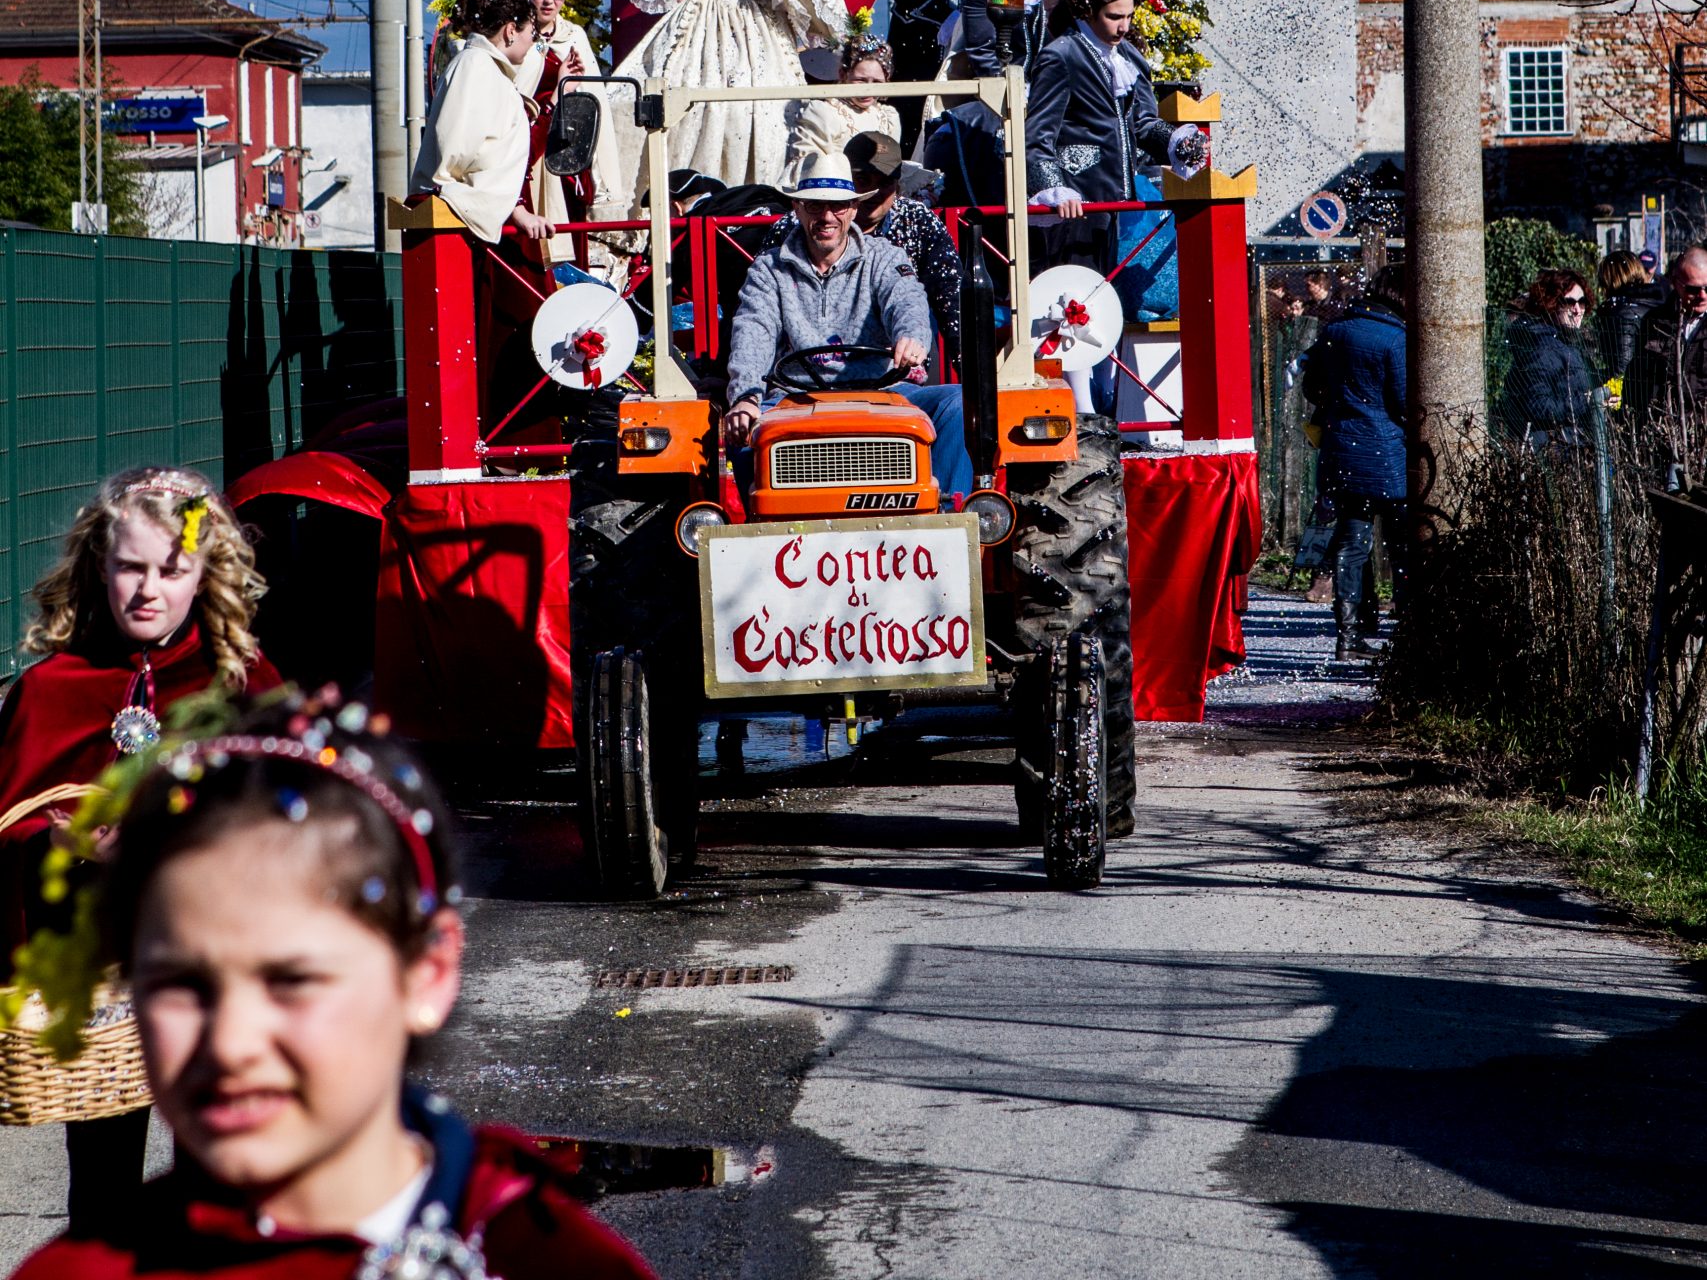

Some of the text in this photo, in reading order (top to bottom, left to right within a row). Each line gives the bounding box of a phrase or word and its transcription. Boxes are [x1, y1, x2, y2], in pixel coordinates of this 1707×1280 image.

[850, 495, 916, 508] FIAT
[774, 535, 938, 589] Contea
[847, 585, 870, 607] di
[732, 605, 969, 673] Castelrosso
